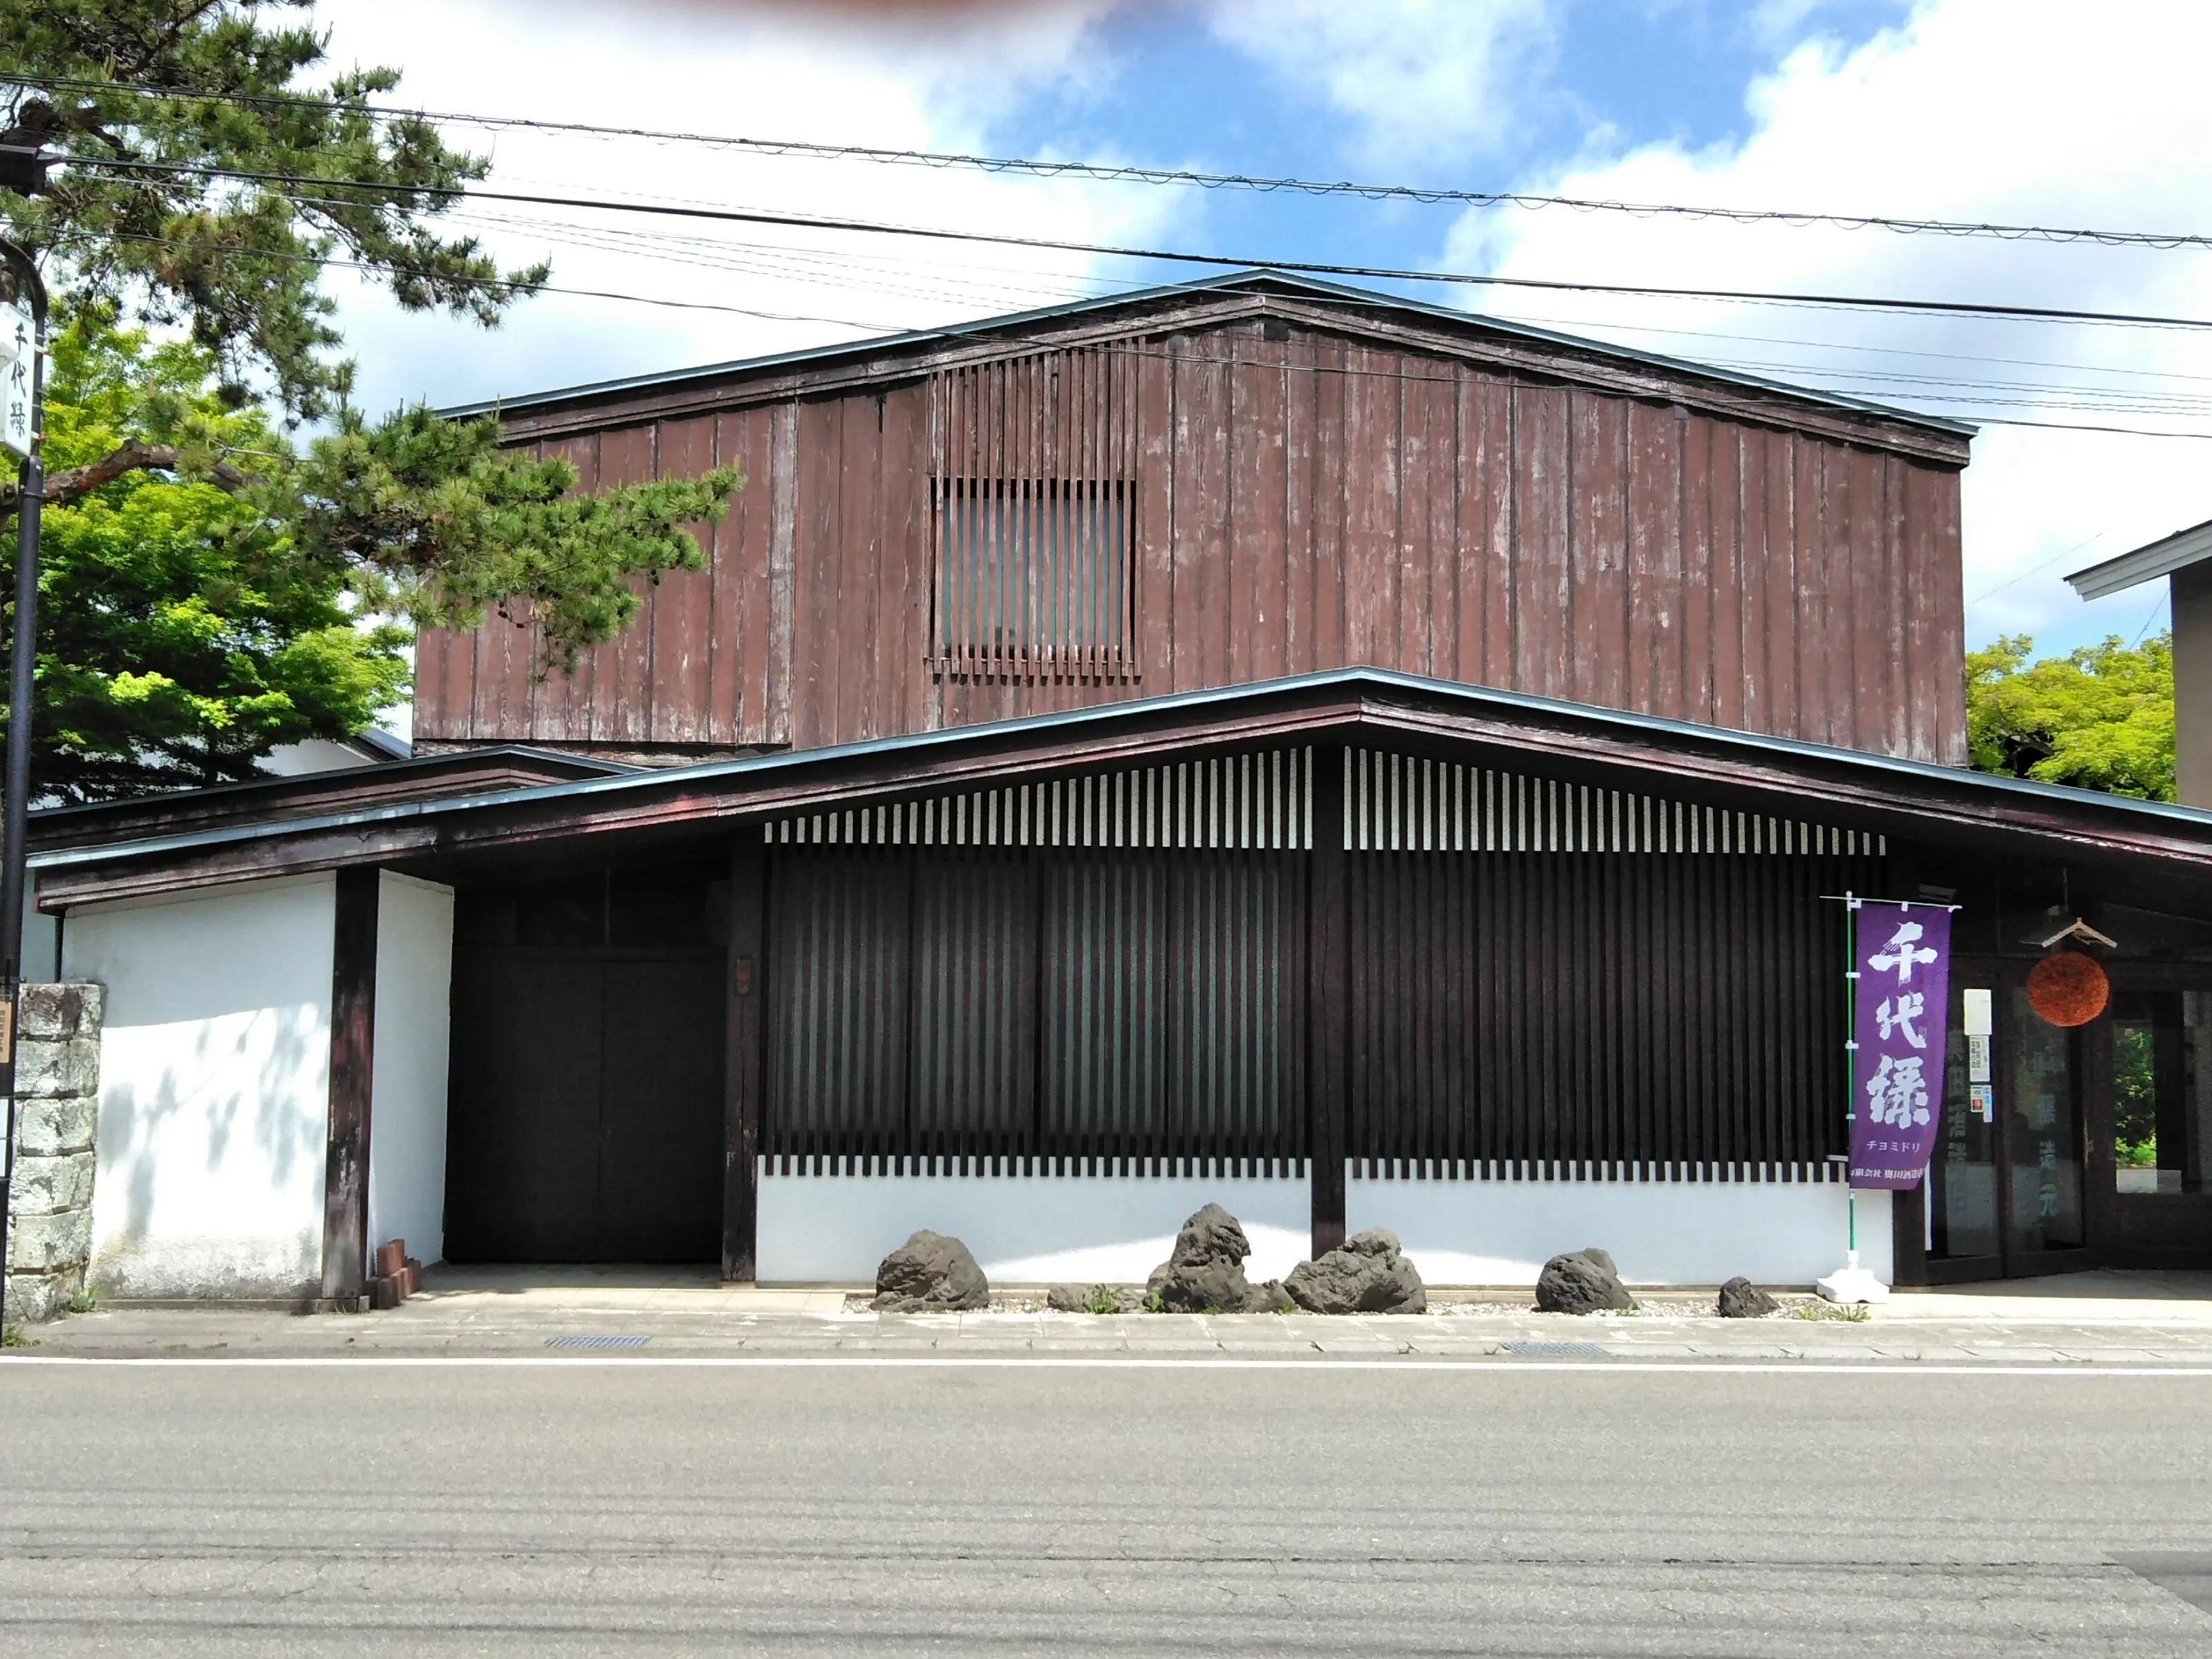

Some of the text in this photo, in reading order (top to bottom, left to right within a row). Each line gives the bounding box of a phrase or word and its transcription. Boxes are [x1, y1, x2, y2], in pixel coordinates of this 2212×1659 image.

[1866, 1140, 1921, 1153] チヨミドリ
